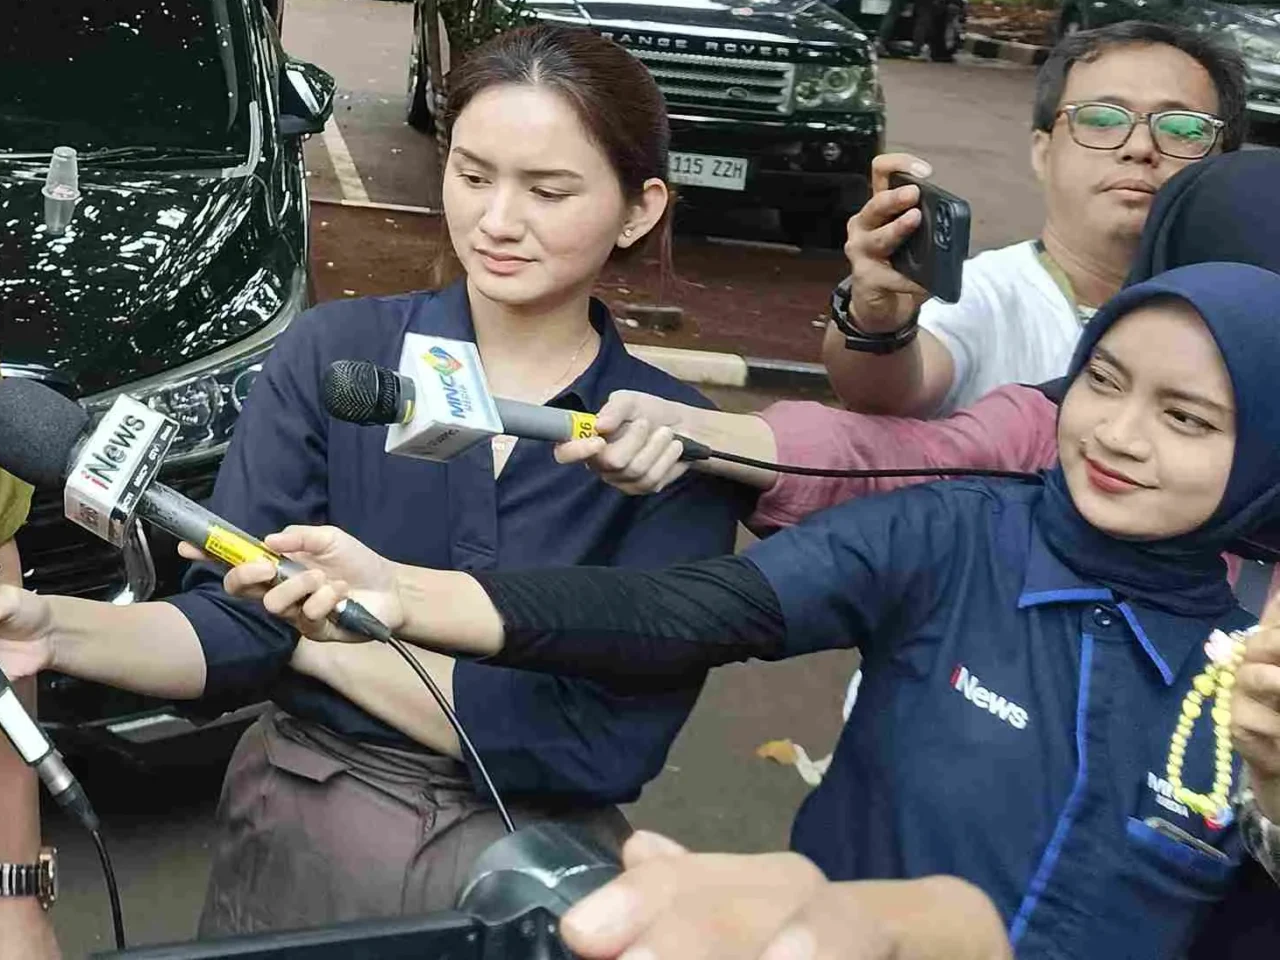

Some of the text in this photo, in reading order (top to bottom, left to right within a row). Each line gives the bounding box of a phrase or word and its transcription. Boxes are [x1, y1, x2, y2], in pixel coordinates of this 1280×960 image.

[601, 31, 790, 57] RANGE ROVER
[712, 159, 743, 178] ZZH
[438, 373, 467, 420] MNC
[80, 414, 146, 490] iNews
[950, 664, 1029, 730] iNews
